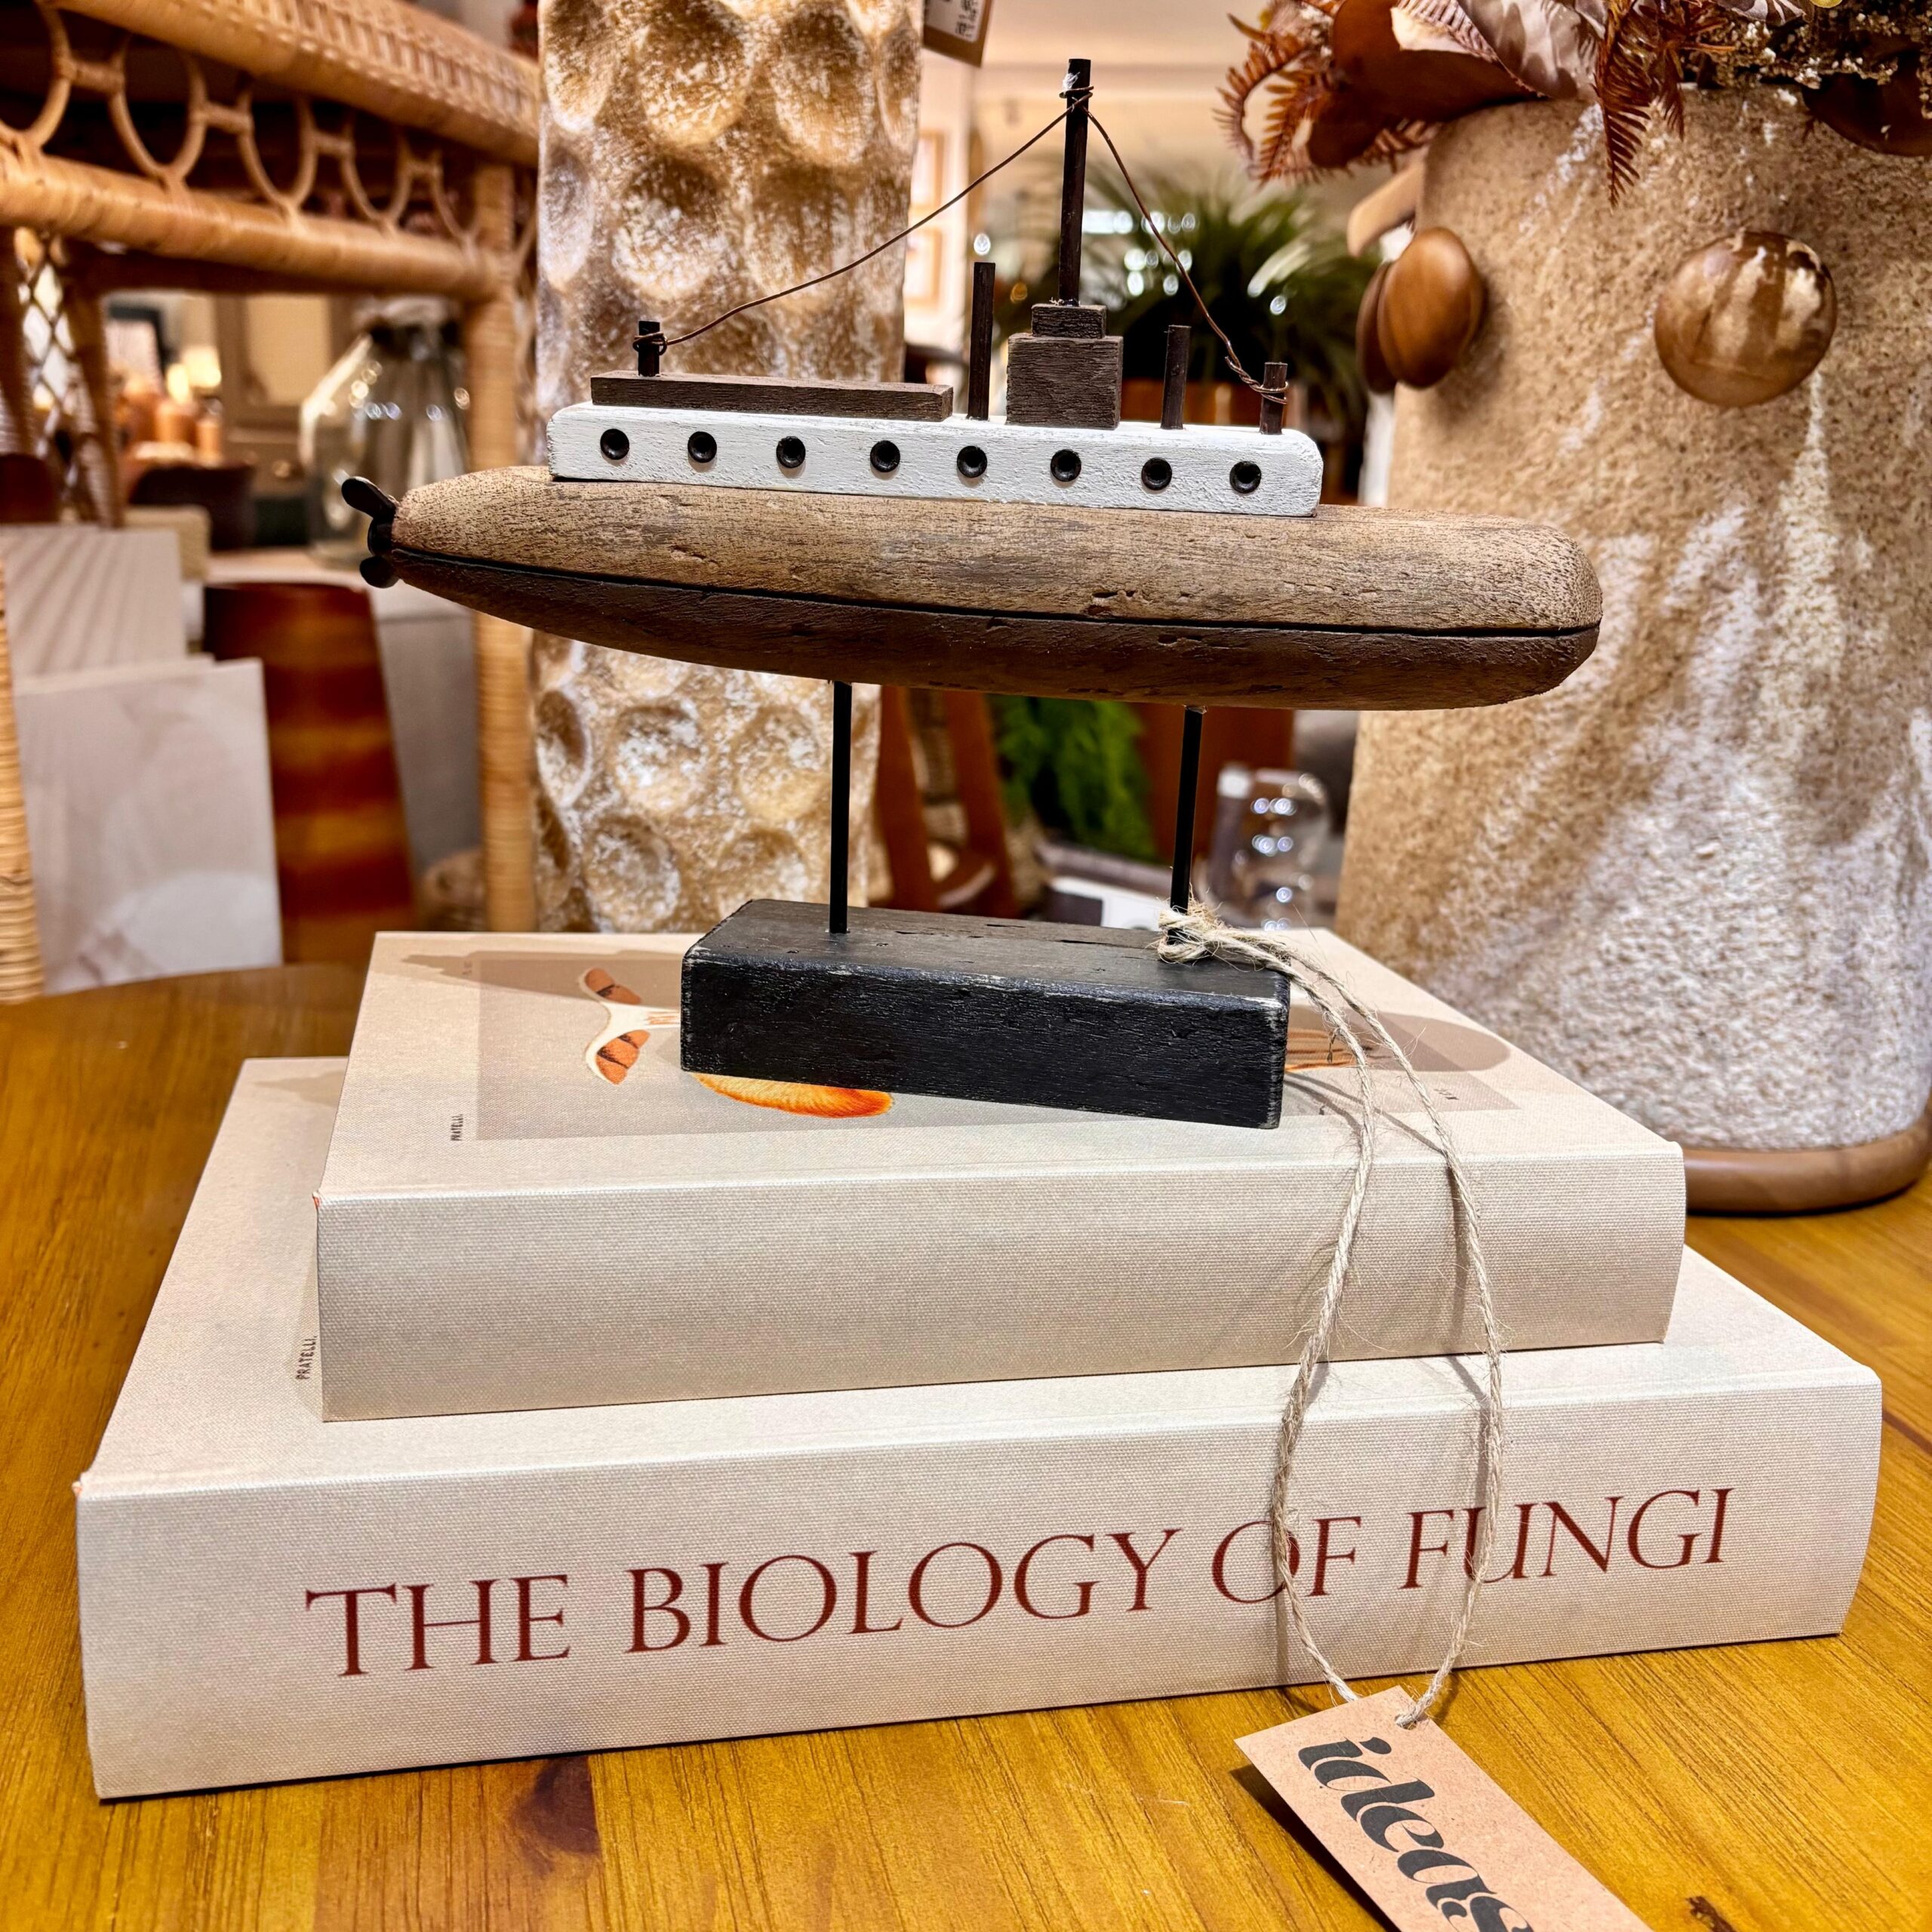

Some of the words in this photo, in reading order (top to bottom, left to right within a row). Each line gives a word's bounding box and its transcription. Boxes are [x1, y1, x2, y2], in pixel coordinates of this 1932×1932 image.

[306, 1574, 571, 1677] THE
[625, 1528, 1183, 1654] BIOLOGY
[1211, 1515, 1361, 1604] OF
[1398, 1487, 1734, 1590] FUNGI
